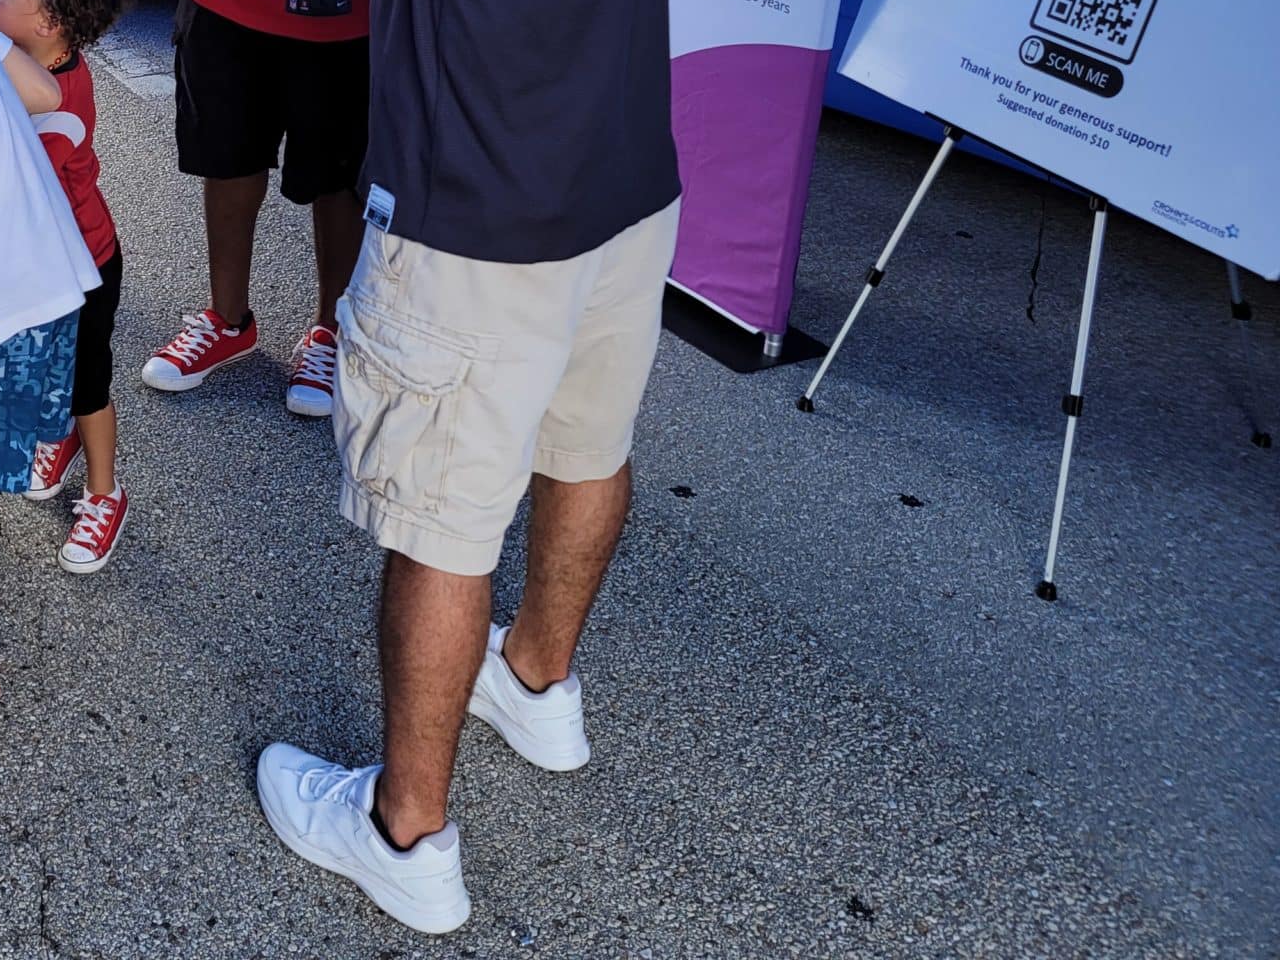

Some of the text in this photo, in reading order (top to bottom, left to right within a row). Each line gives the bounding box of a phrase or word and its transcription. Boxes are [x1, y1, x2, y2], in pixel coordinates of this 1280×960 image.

[1046, 53, 1110, 89] SCAN ME
[959, 56, 1173, 158] Thank you for your generous support!
[996, 93, 1110, 151] Suggested donation $10
